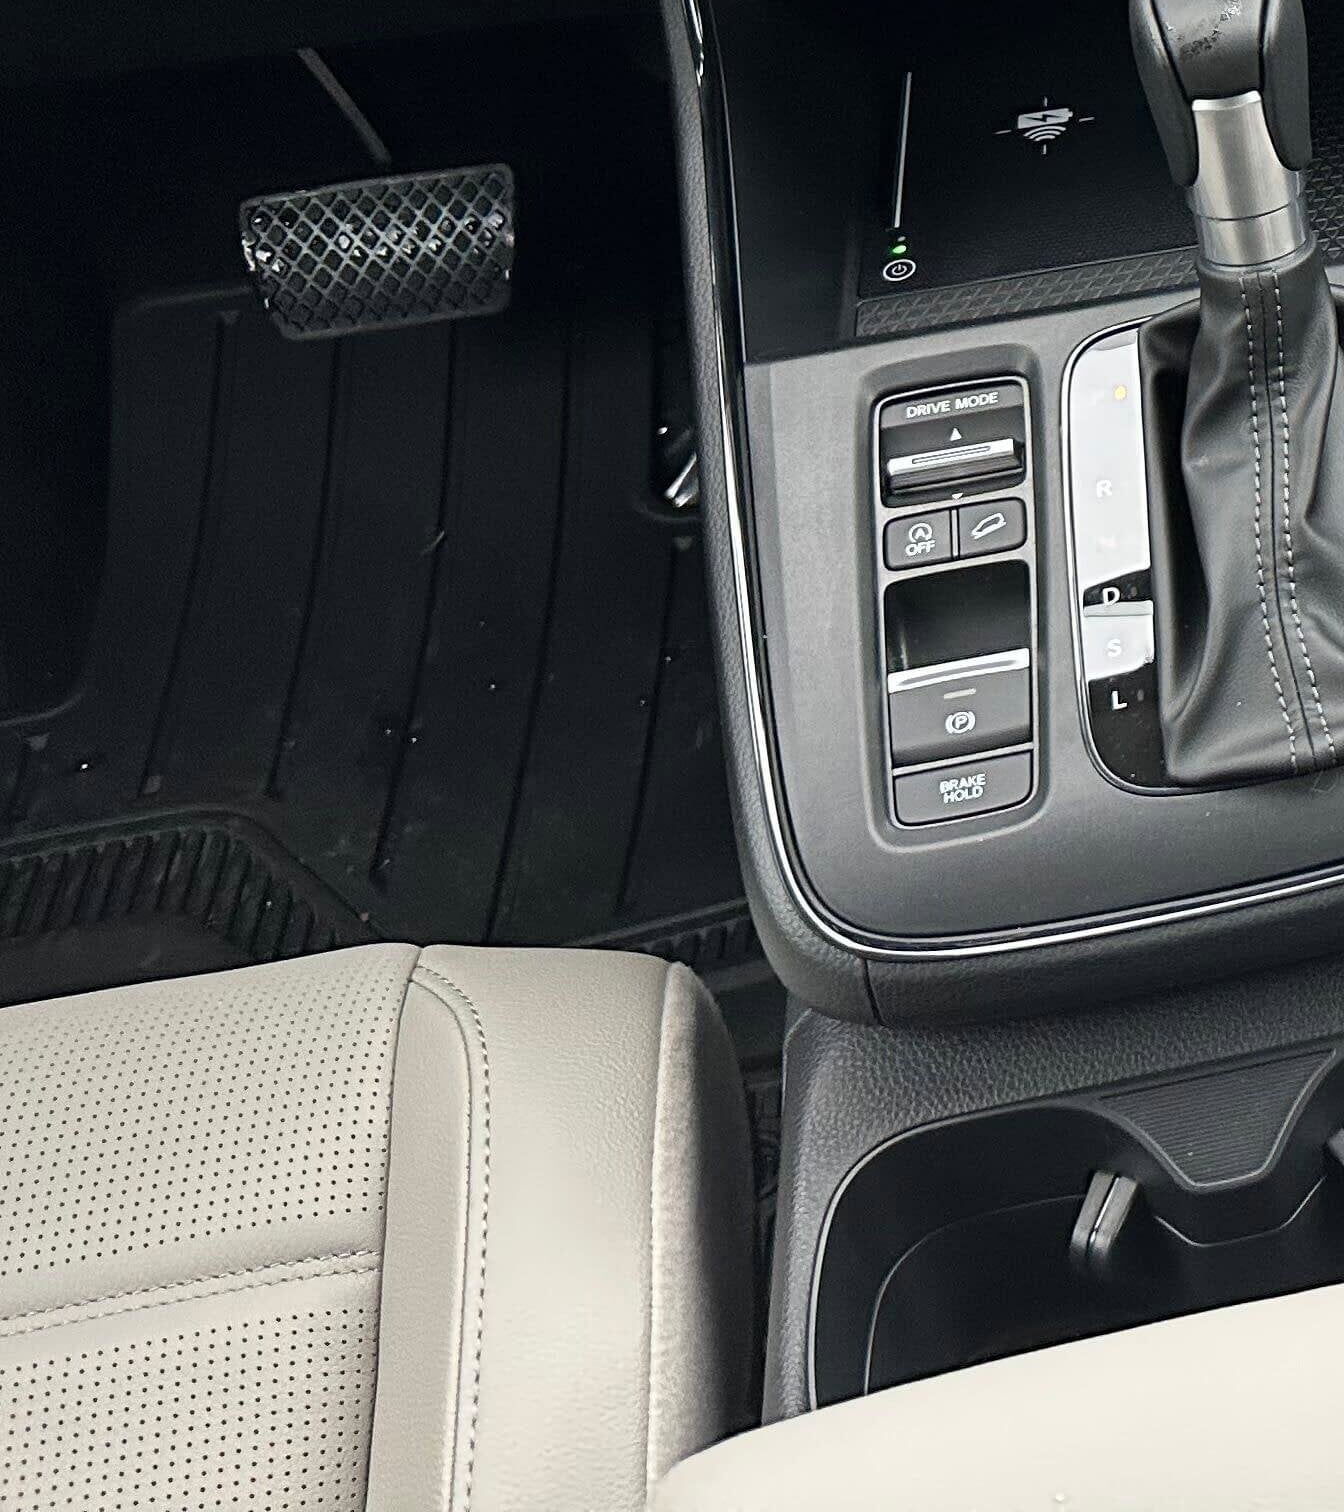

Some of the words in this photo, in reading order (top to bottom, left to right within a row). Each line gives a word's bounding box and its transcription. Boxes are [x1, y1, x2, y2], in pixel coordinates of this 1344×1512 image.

[906, 400, 951, 419] DRIVE
[955, 391, 999, 410] MODE
[1095, 479, 1113, 498] R
[905, 540, 935, 556] OFF
[1101, 586, 1121, 606] D
[1107, 638, 1122, 658] S
[1111, 690, 1128, 710] L
[940, 773, 986, 794] BRAKE
[943, 786, 984, 803] HOLD
